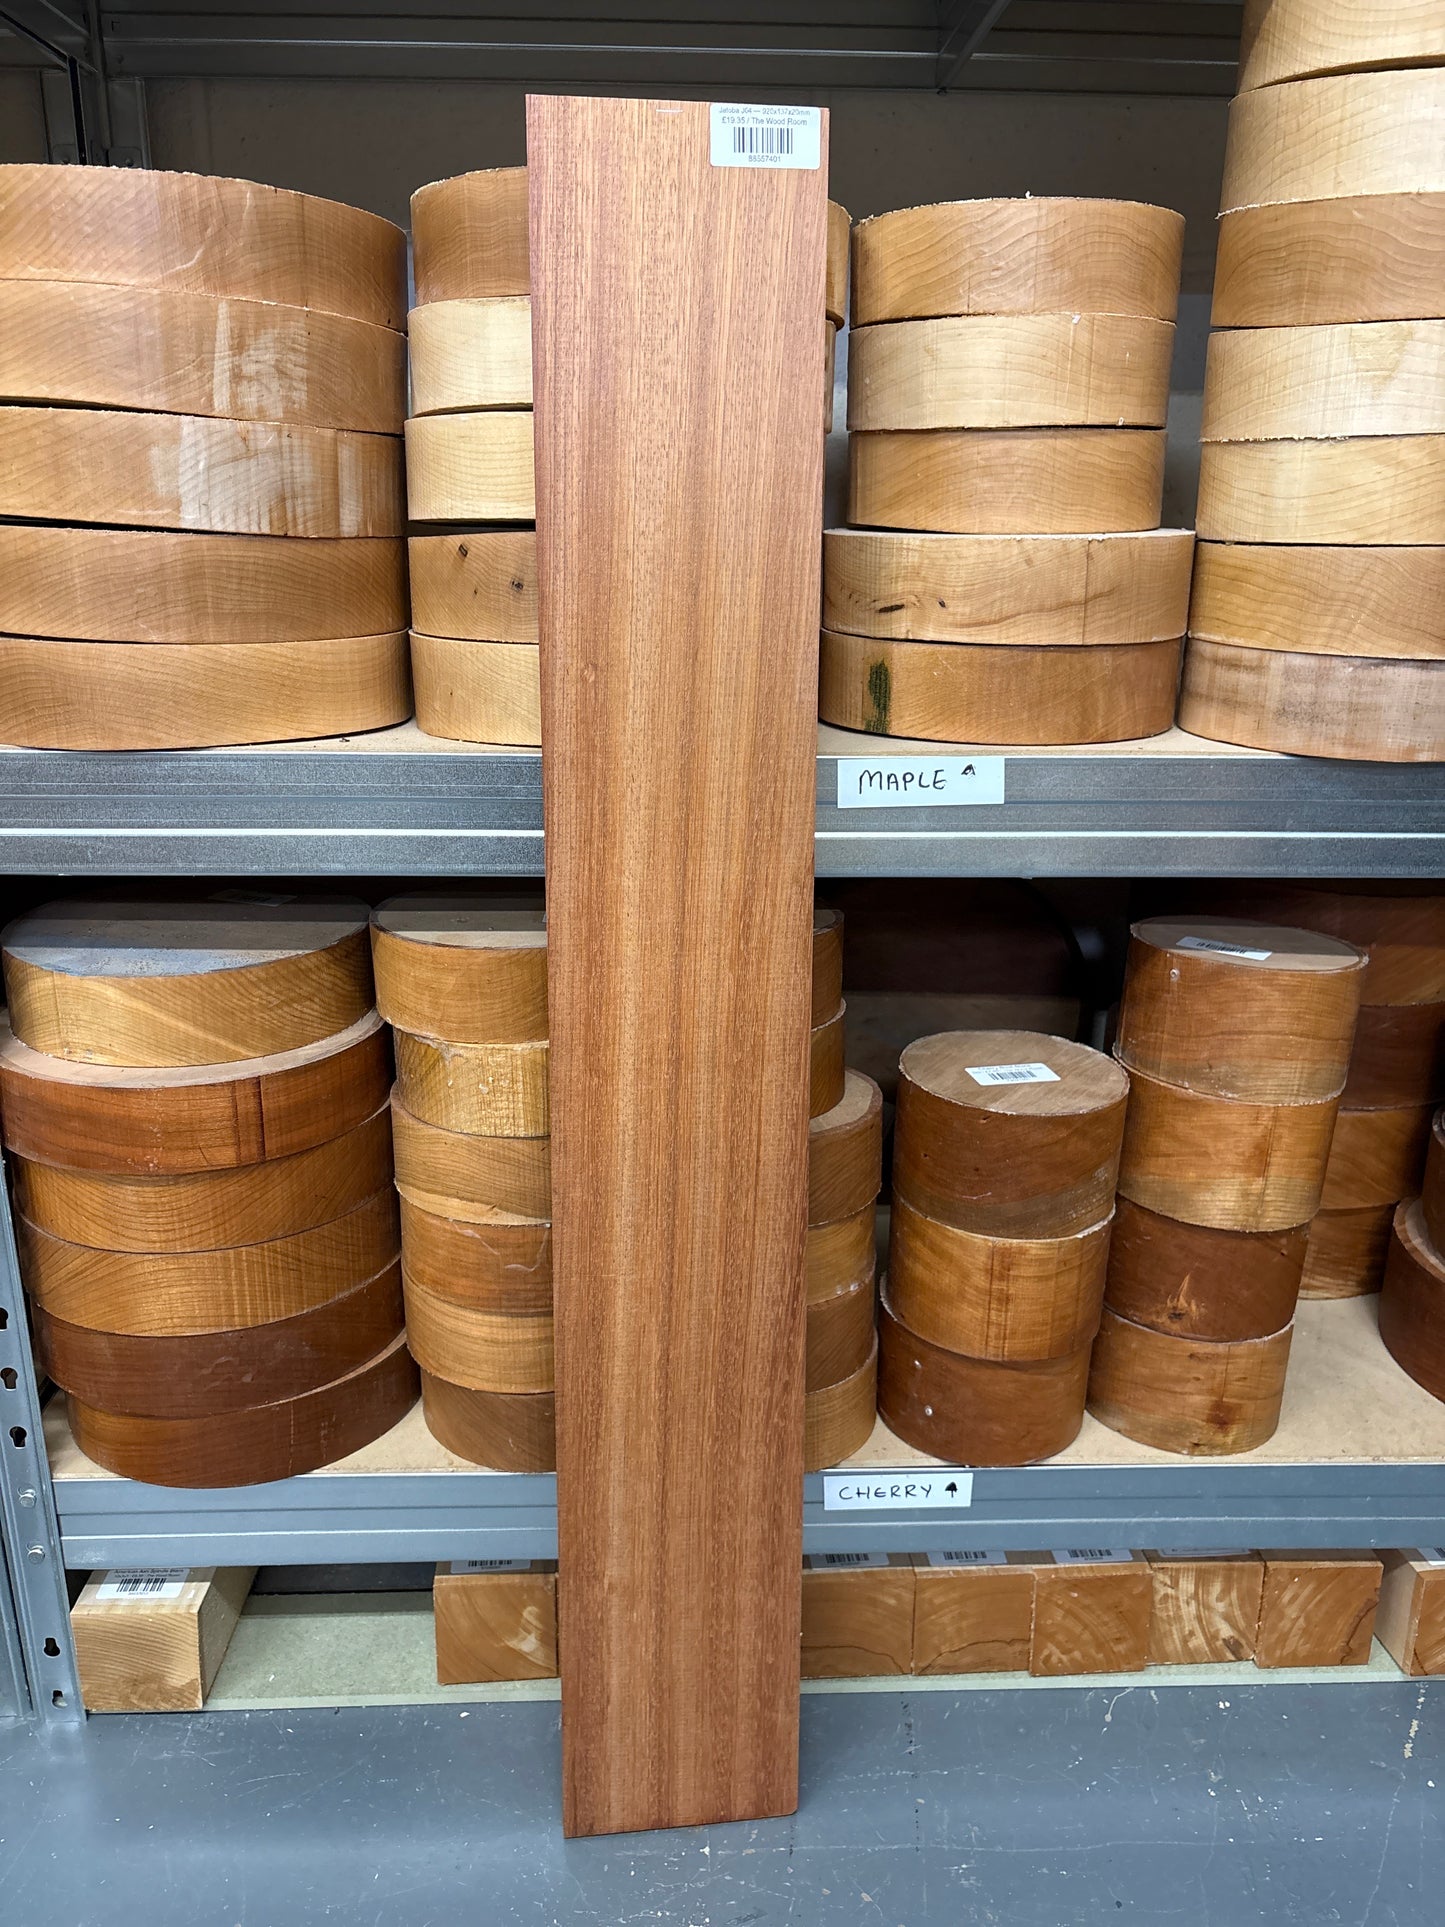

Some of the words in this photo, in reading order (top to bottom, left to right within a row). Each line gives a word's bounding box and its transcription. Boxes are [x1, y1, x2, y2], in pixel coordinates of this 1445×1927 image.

[719, 106, 740, 114] Jatoba
[722, 116, 746, 124] £19.35
[751, 117, 765, 125] The
[787, 118, 808, 126] Room
[859, 769, 948, 795] MAPLE
[838, 1483, 932, 1501] CHERRY
